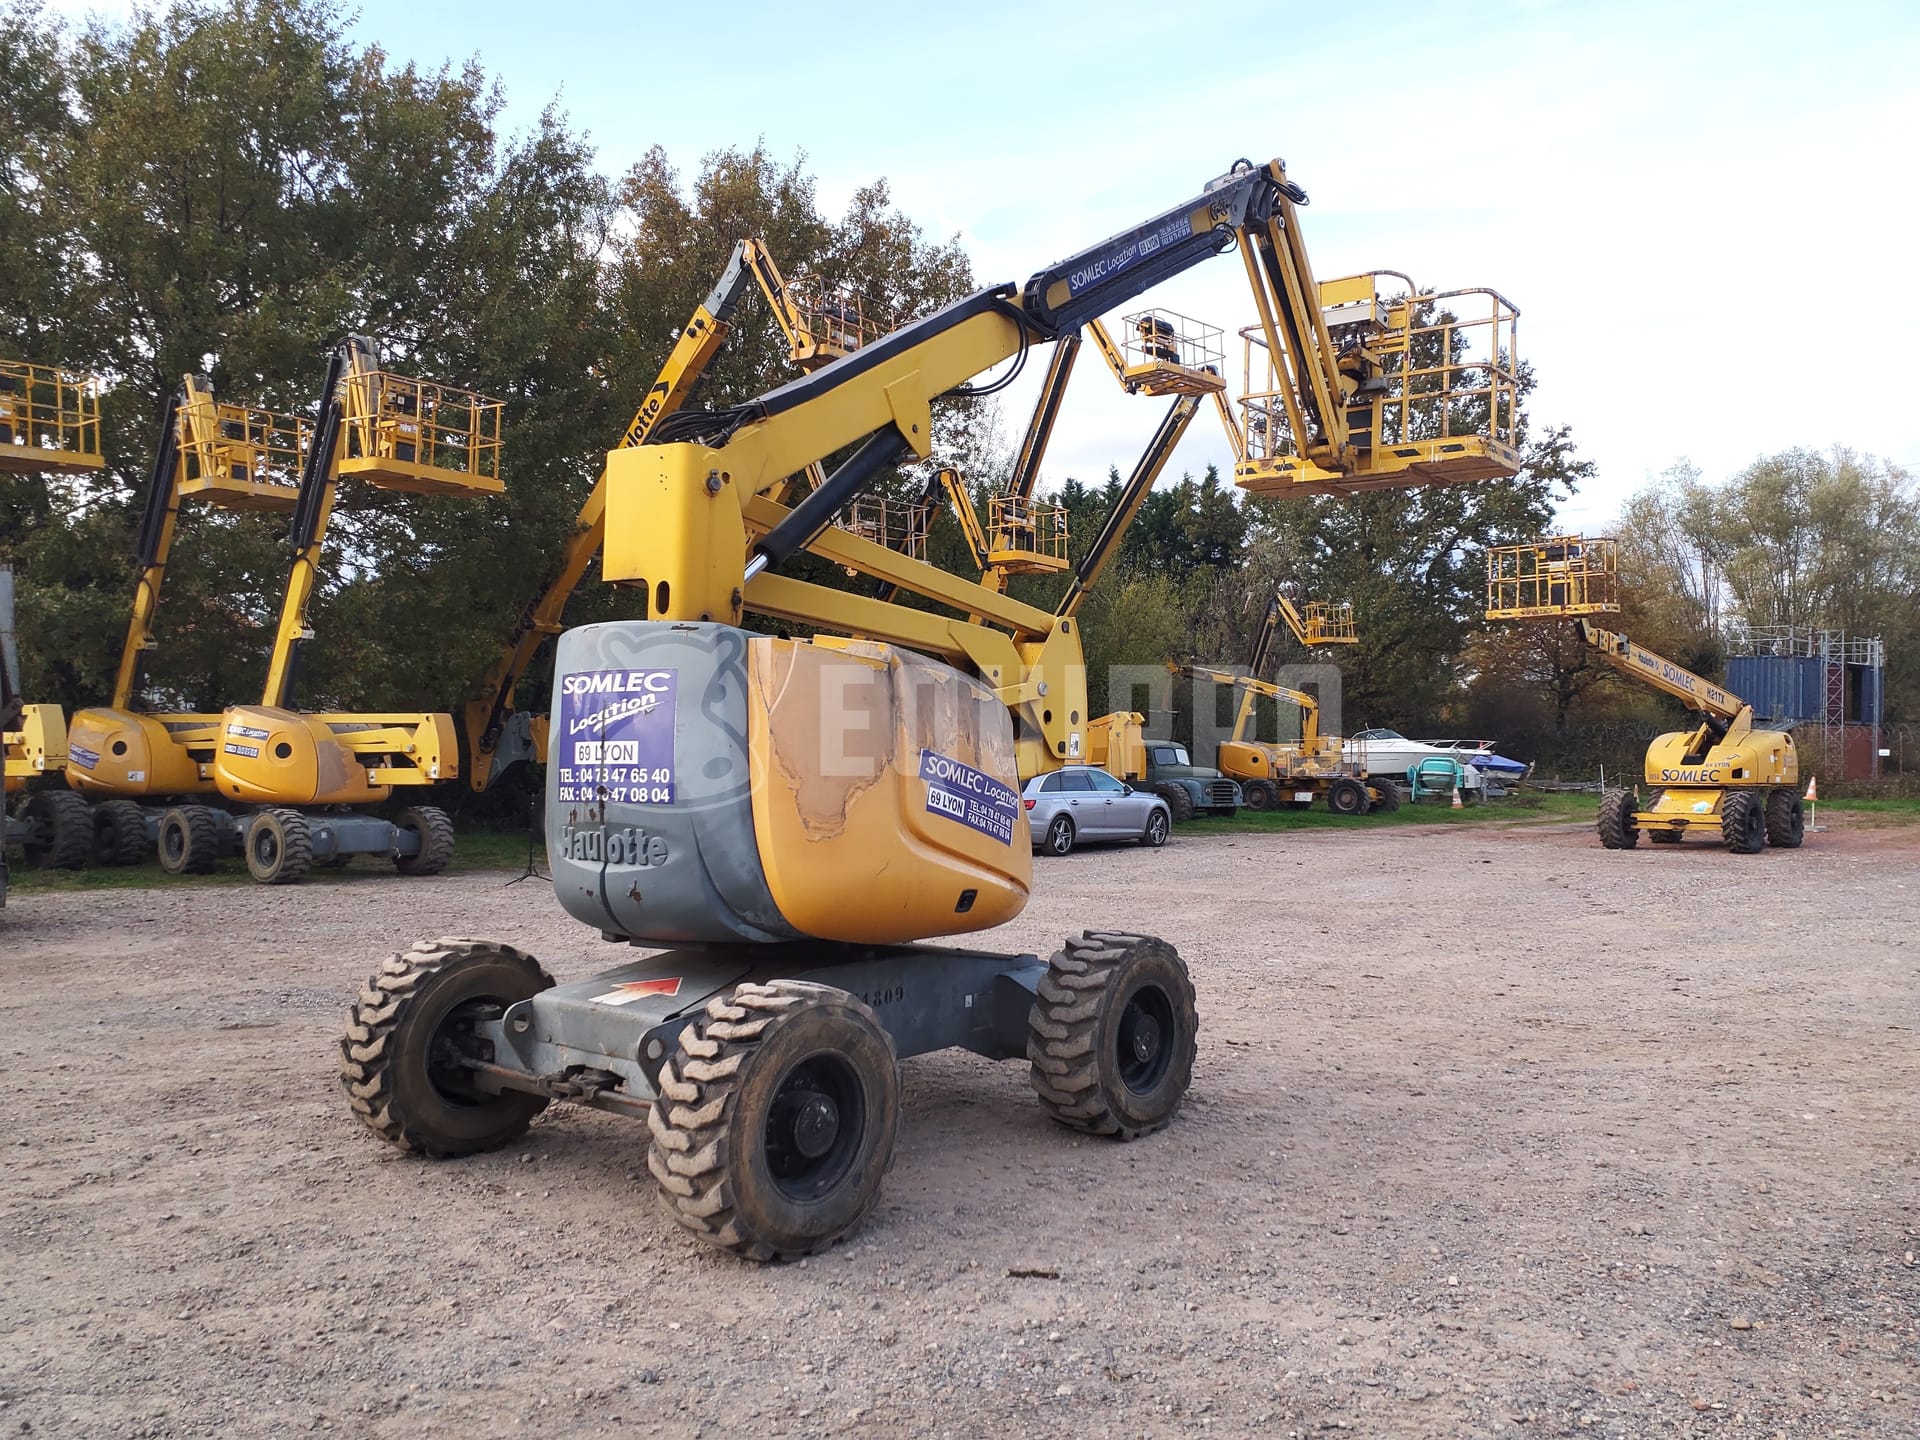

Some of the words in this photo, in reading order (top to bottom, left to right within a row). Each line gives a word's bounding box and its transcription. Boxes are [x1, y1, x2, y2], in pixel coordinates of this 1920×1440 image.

[1071, 260, 1107, 290] SOMLEC
[1107, 244, 1137, 271] Location
[562, 672, 671, 695] SOMLEC
[1663, 663, 1696, 692] SOMLEC
[570, 693, 656, 736] Location
[579, 745, 591, 761] 69
[595, 745, 633, 761] LYON
[580, 768, 593, 783] 04
[611, 768, 628, 783] 47
[630, 768, 648, 783] 65
[651, 768, 670, 783] 40
[925, 756, 983, 793] SOMLEC
[984, 780, 1018, 809] Location
[1661, 769, 1720, 782] SOMLEC
[611, 787, 628, 802] 47
[630, 787, 648, 802] 08
[651, 787, 670, 803] 04
[930, 790, 941, 806] 69
[942, 793, 964, 816] LYON
[561, 824, 668, 867] Haulotte
